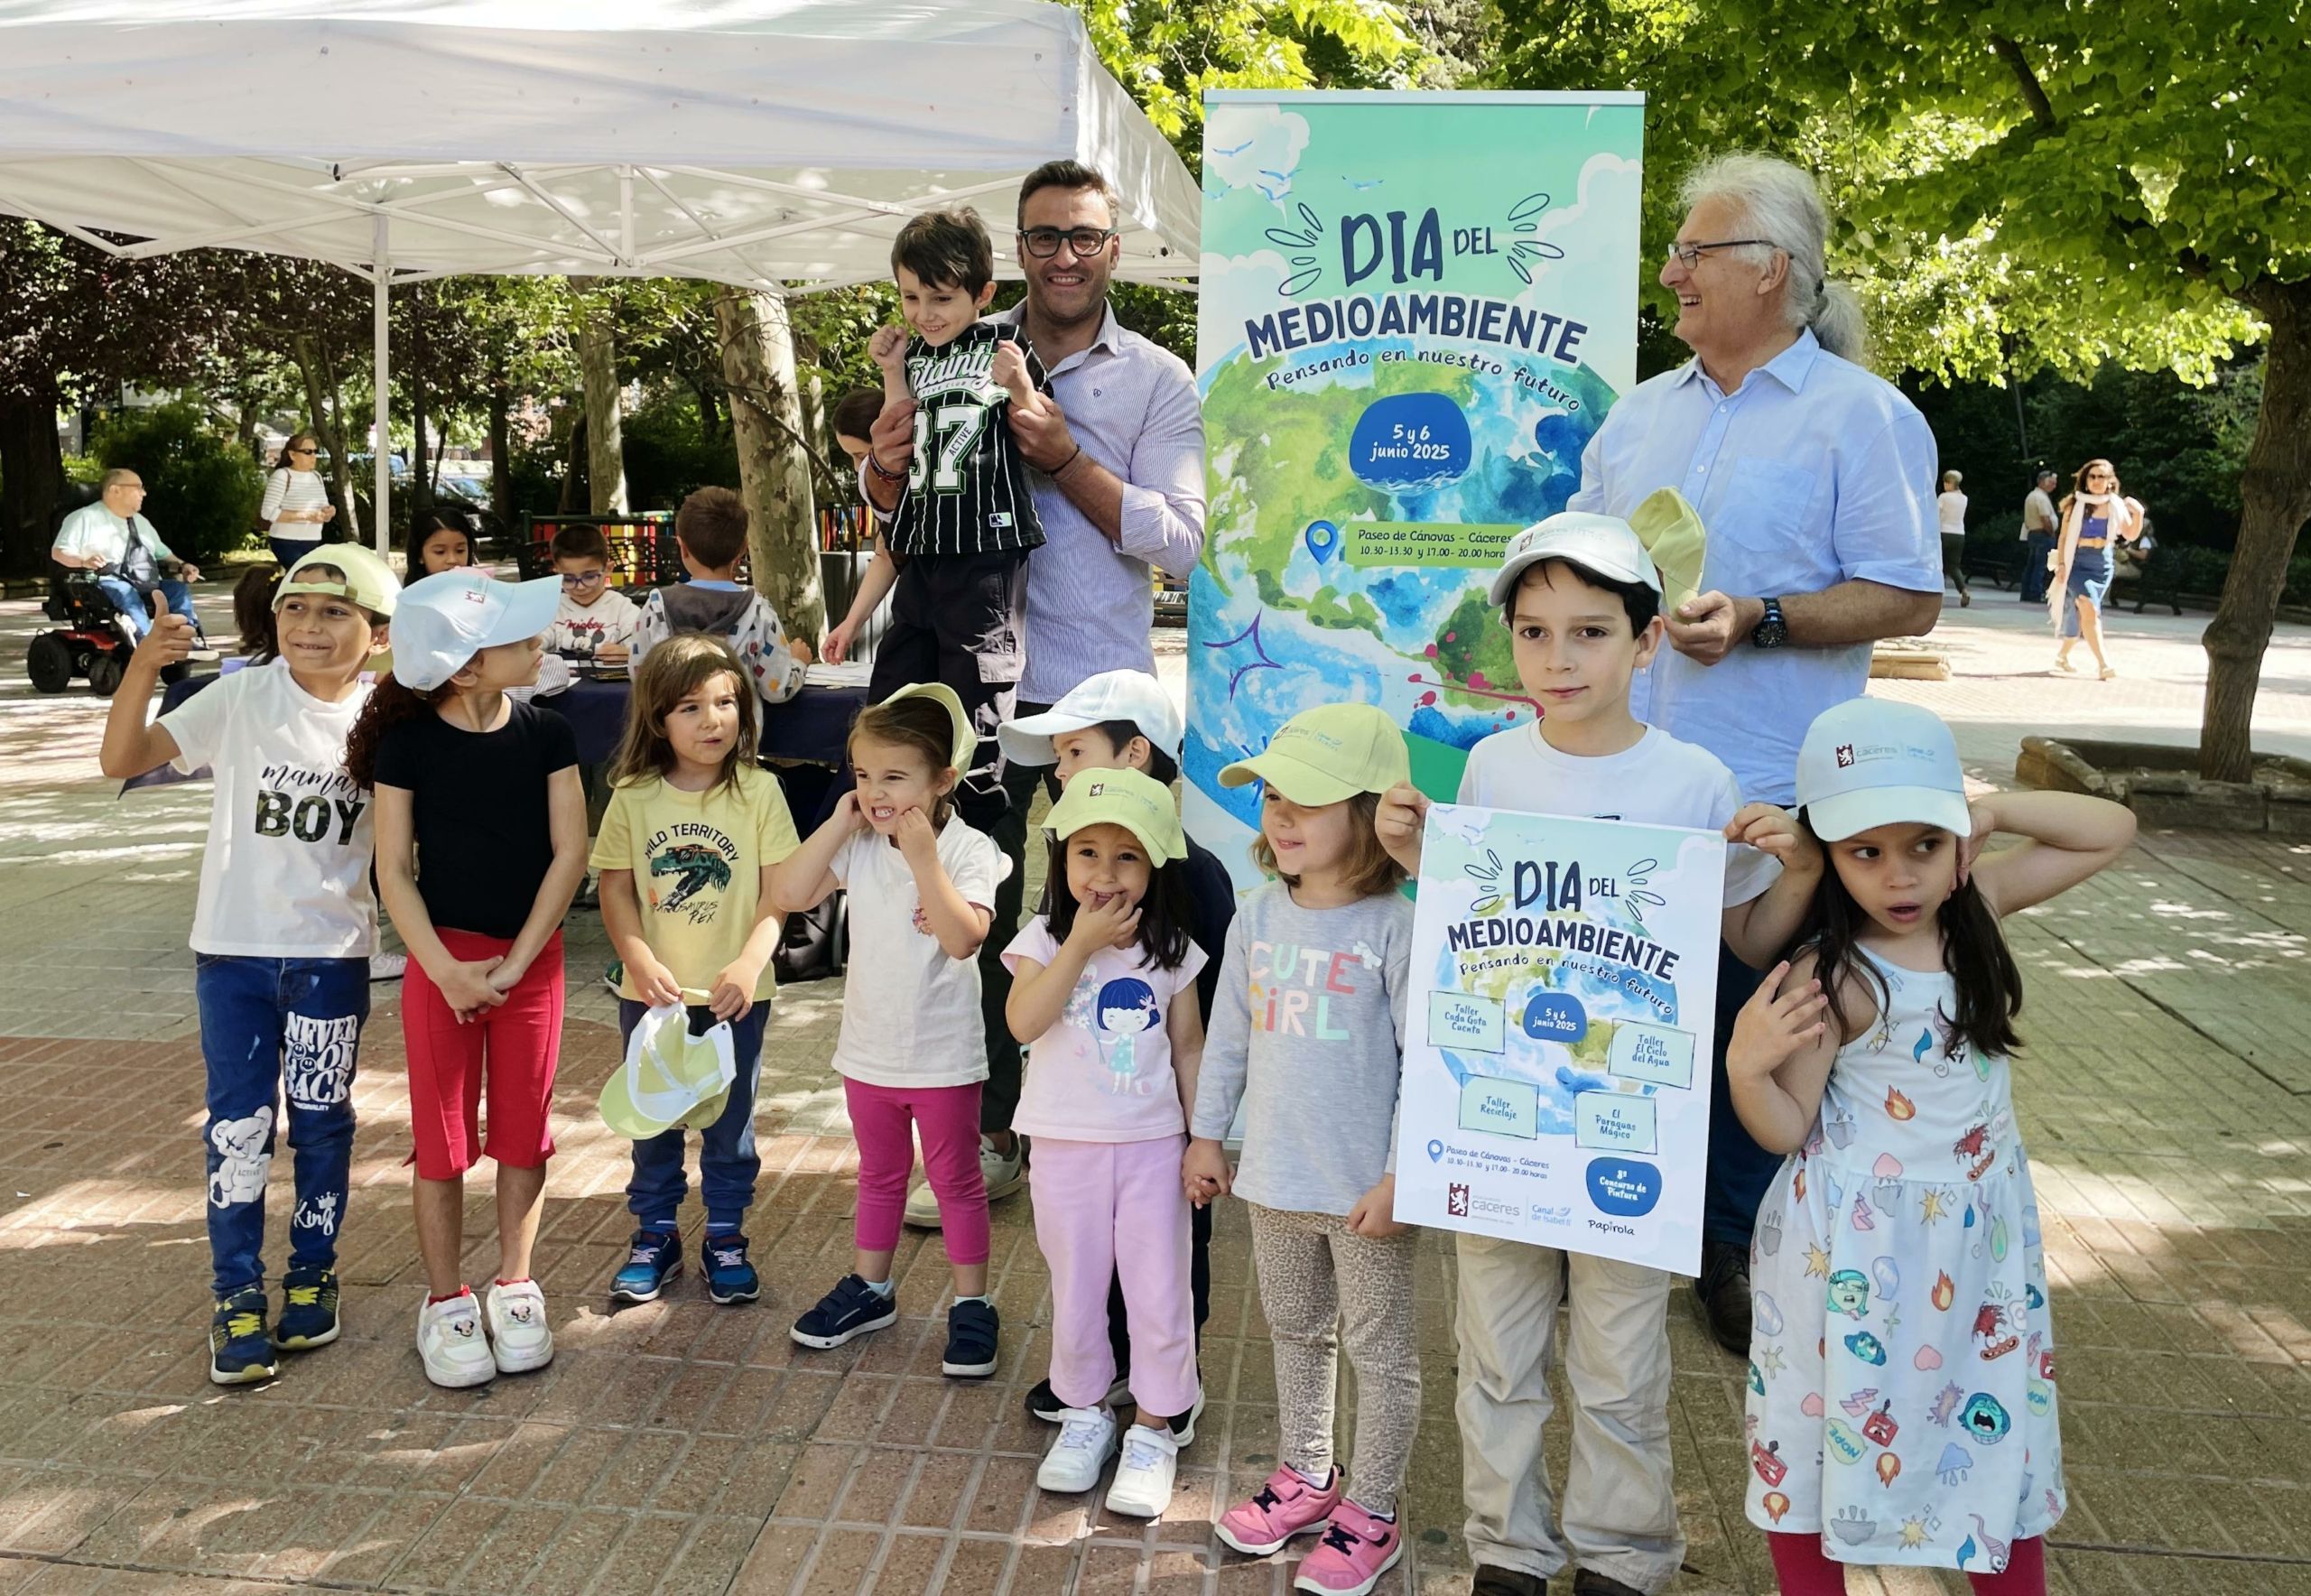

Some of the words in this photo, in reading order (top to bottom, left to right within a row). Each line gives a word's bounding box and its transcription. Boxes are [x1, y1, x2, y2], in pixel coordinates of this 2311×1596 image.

[1341, 207, 1443, 287] DIA
[1453, 227, 1498, 256] DEL
[1245, 294, 1588, 363] MEDIOAMBIENTE
[1267, 349, 1369, 390] Pensando
[1381, 350, 1406, 362] en
[1418, 350, 1502, 376] nuestro
[1514, 367, 1580, 411] futuro
[948, 426, 972, 456] ACTIVE
[1393, 424, 1404, 440] 5
[1407, 429, 1415, 444] y
[1419, 425, 1431, 441] 6
[1369, 441, 1408, 462] junio
[1413, 443, 1450, 459] 2025
[1359, 529, 1389, 542] Paseo
[1393, 530, 1406, 542] de
[1410, 530, 1454, 543] Cánovas
[1469, 532, 1513, 543] Cáceres
[1417, 549, 1424, 559] y
[1458, 548, 1482, 558] 20.00
[1484, 547, 1505, 558] hora
[255, 790, 365, 846] BOY
[645, 830, 669, 858] WILD
[671, 823, 739, 862] TERRITORY
[1514, 860, 1582, 912] DIA
[1589, 877, 1620, 897] DEL
[689, 910, 715, 925] REX
[1447, 918, 1679, 980] MEDIOAMBIENTE
[1249, 941, 1362, 994] CUTE
[1460, 953, 1528, 975] Pensando
[1537, 957, 1554, 966] en
[1562, 960, 1620, 983] nuestro
[1626, 979, 1673, 1015] futuro
[1444, 1012, 1465, 1023] Cada
[1454, 1004, 1479, 1016] Taller
[1545, 1008, 1552, 1016] 5
[1553, 1011, 1559, 1019] y
[1560, 1010, 1566, 1019] 6
[1452, 1022, 1480, 1035] Cuenta
[1533, 1016, 1555, 1027] junio
[1556, 1021, 1577, 1031] 2025
[283, 1011, 357, 1053] NEVER
[1638, 1035, 1665, 1046] Taller
[1636, 1044, 1643, 1053] El
[1647, 1045, 1667, 1057] Ciclo
[1632, 1053, 1645, 1062] del
[1647, 1055, 1670, 1067] Agua
[1486, 1096, 1510, 1109] Taller
[1480, 1104, 1517, 1120] Reciclaje
[1612, 1109, 1620, 1118] El
[1595, 1115, 1636, 1131] Paraguas
[1446, 1146, 1467, 1155] Paseo
[1599, 1176, 1635, 1191] Concurso
[1637, 1183, 1647, 1193] de
[1607, 1187, 1638, 1201] Pintura
[293, 1199, 337, 1236] King
[1532, 1205, 1554, 1215] Canal
[1587, 1220, 1636, 1235] Papirola
[2028, 1391, 2047, 1406] NOP
[1829, 1429, 1861, 1458] NOPE
